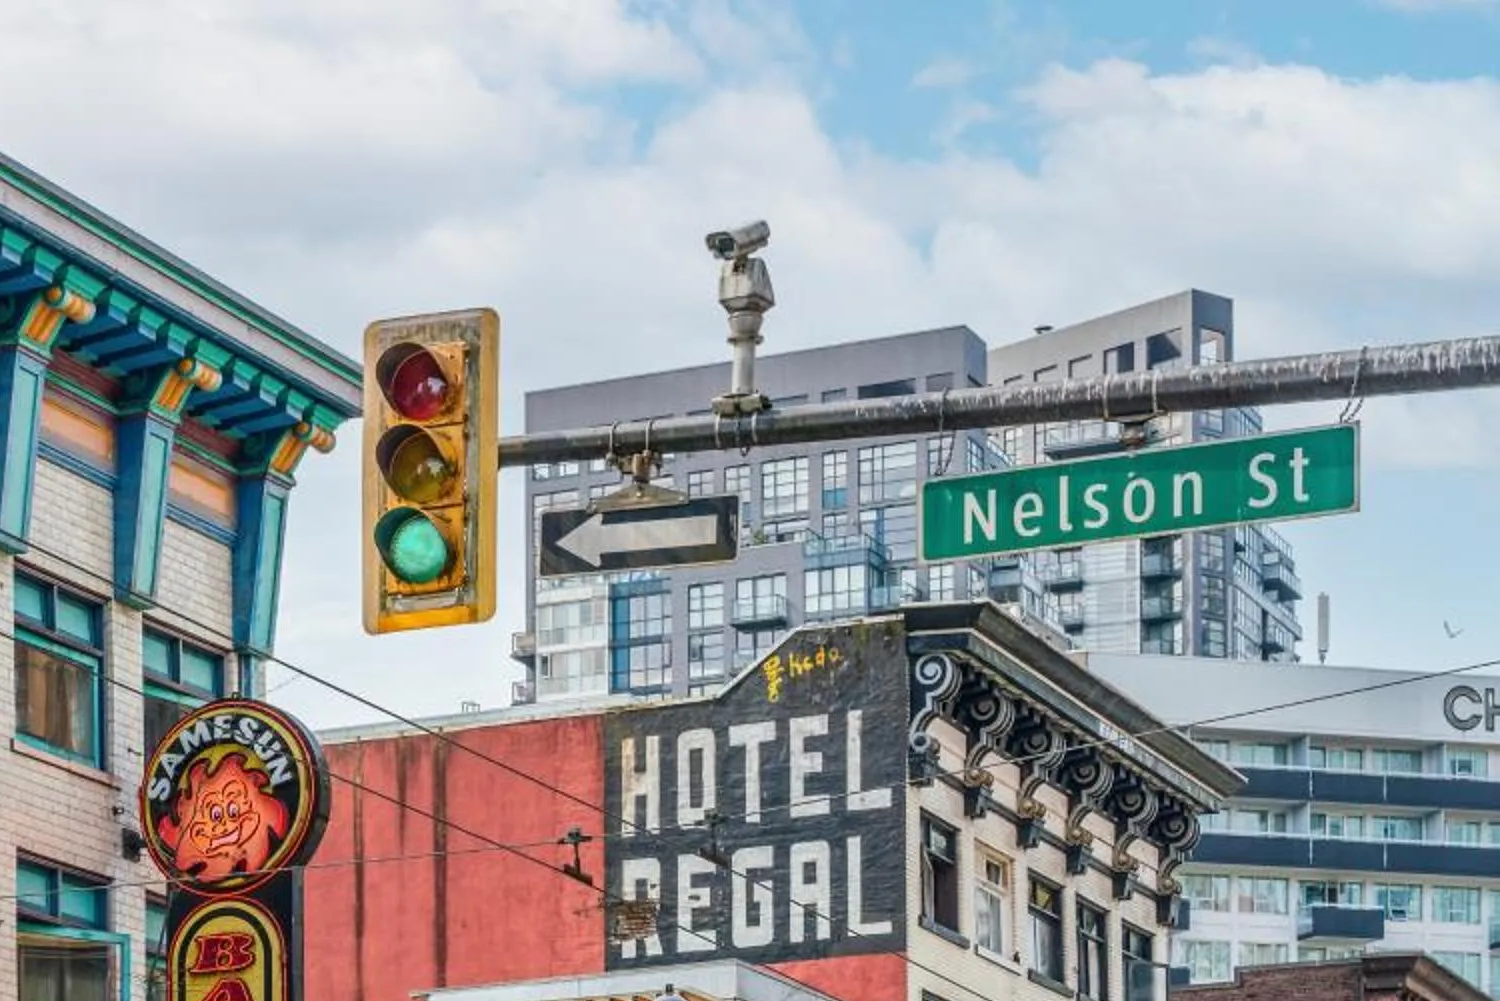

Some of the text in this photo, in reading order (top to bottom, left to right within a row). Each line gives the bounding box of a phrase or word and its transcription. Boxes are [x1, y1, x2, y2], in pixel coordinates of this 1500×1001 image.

[963, 447, 1310, 545] Nelson St
[148, 714, 293, 801] SAMESUN
[620, 710, 892, 838] HOTEL
[620, 836, 892, 959] REGAL
